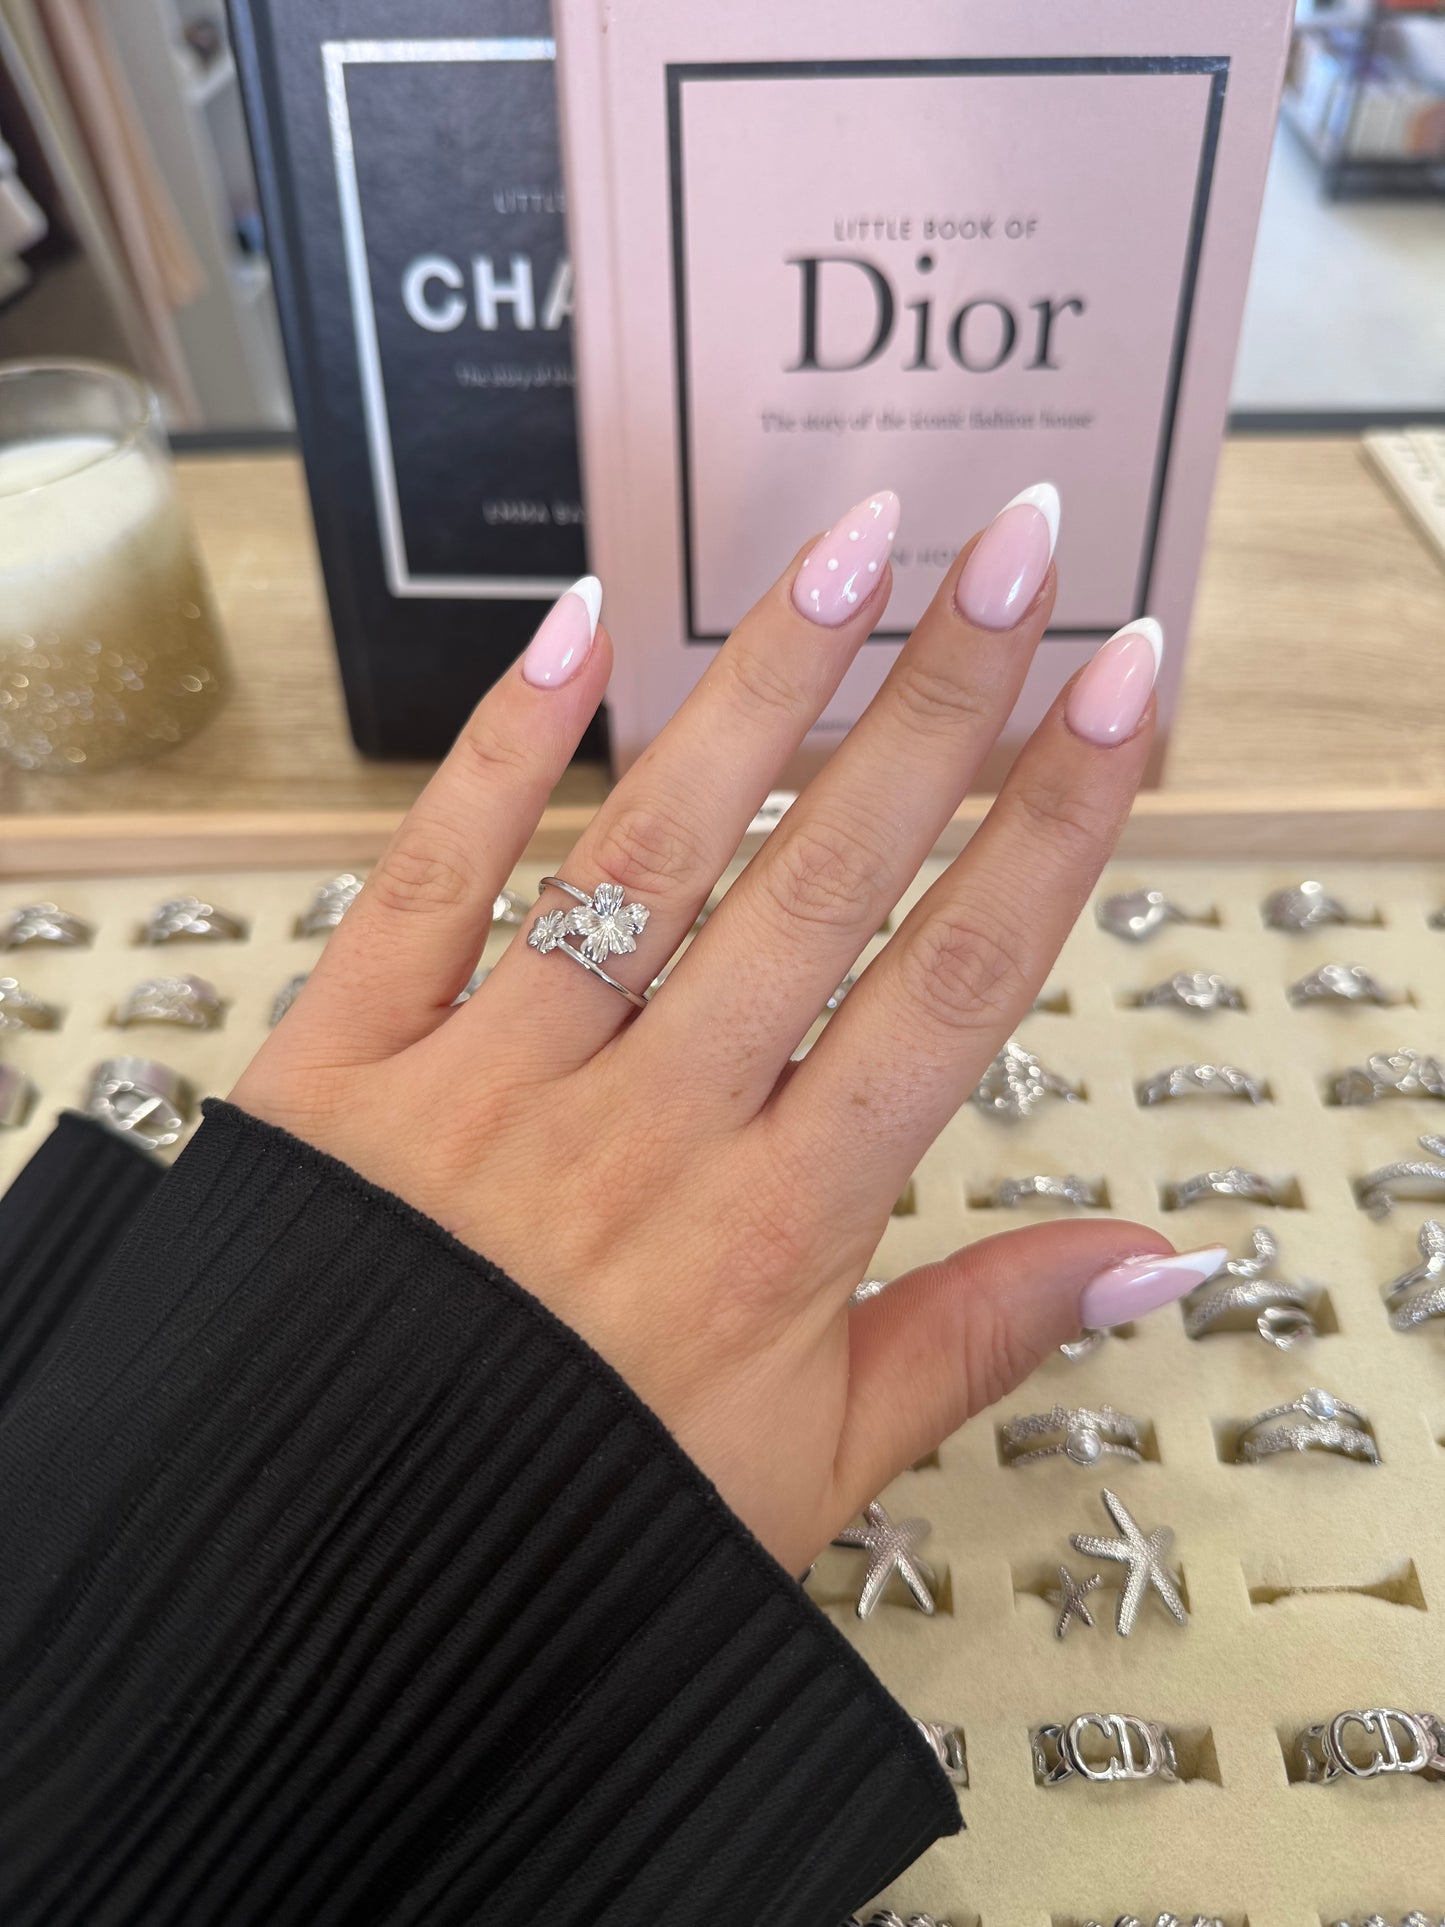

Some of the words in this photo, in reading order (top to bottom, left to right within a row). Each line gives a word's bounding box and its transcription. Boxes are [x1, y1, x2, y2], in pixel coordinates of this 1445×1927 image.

[834, 216, 912, 241] LITTLE
[923, 216, 993, 240] BOOK
[1005, 216, 1039, 240] OF
[782, 250, 1084, 373] Dior
[761, 410, 798, 433] The
[849, 409, 874, 432] of
[875, 409, 907, 432] the
